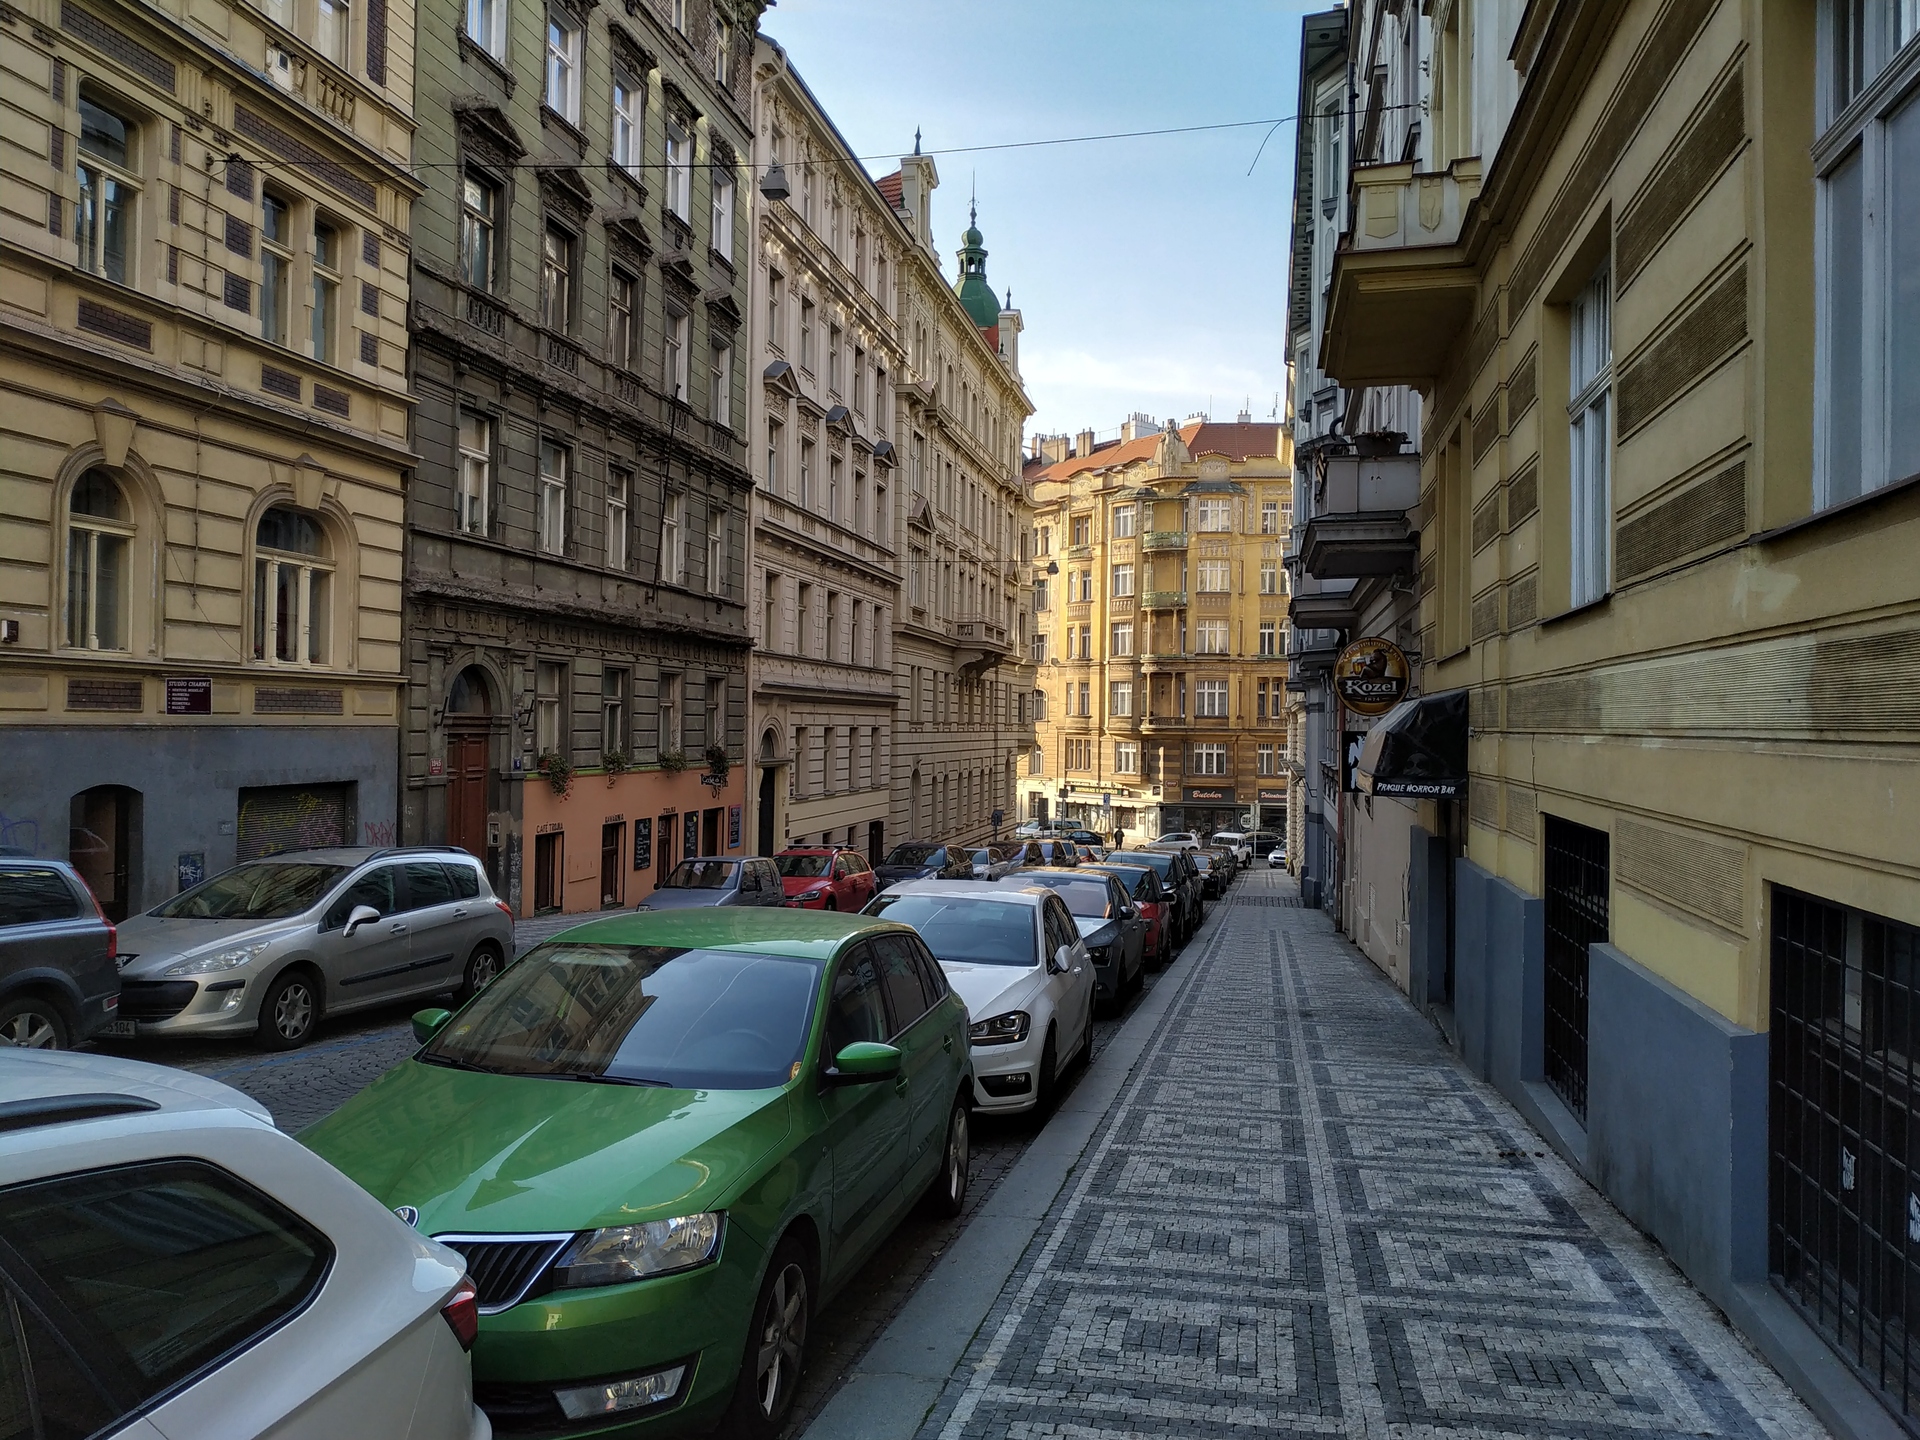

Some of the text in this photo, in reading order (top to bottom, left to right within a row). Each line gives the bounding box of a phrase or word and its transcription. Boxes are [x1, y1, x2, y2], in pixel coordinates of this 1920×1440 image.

[1345, 679, 1398, 695] Kozel
[1377, 782, 1456, 794] PRAGUE HORROR BAR
[1192, 790, 1222, 799] Butcher
[536, 821, 548, 833] CAFÉ
